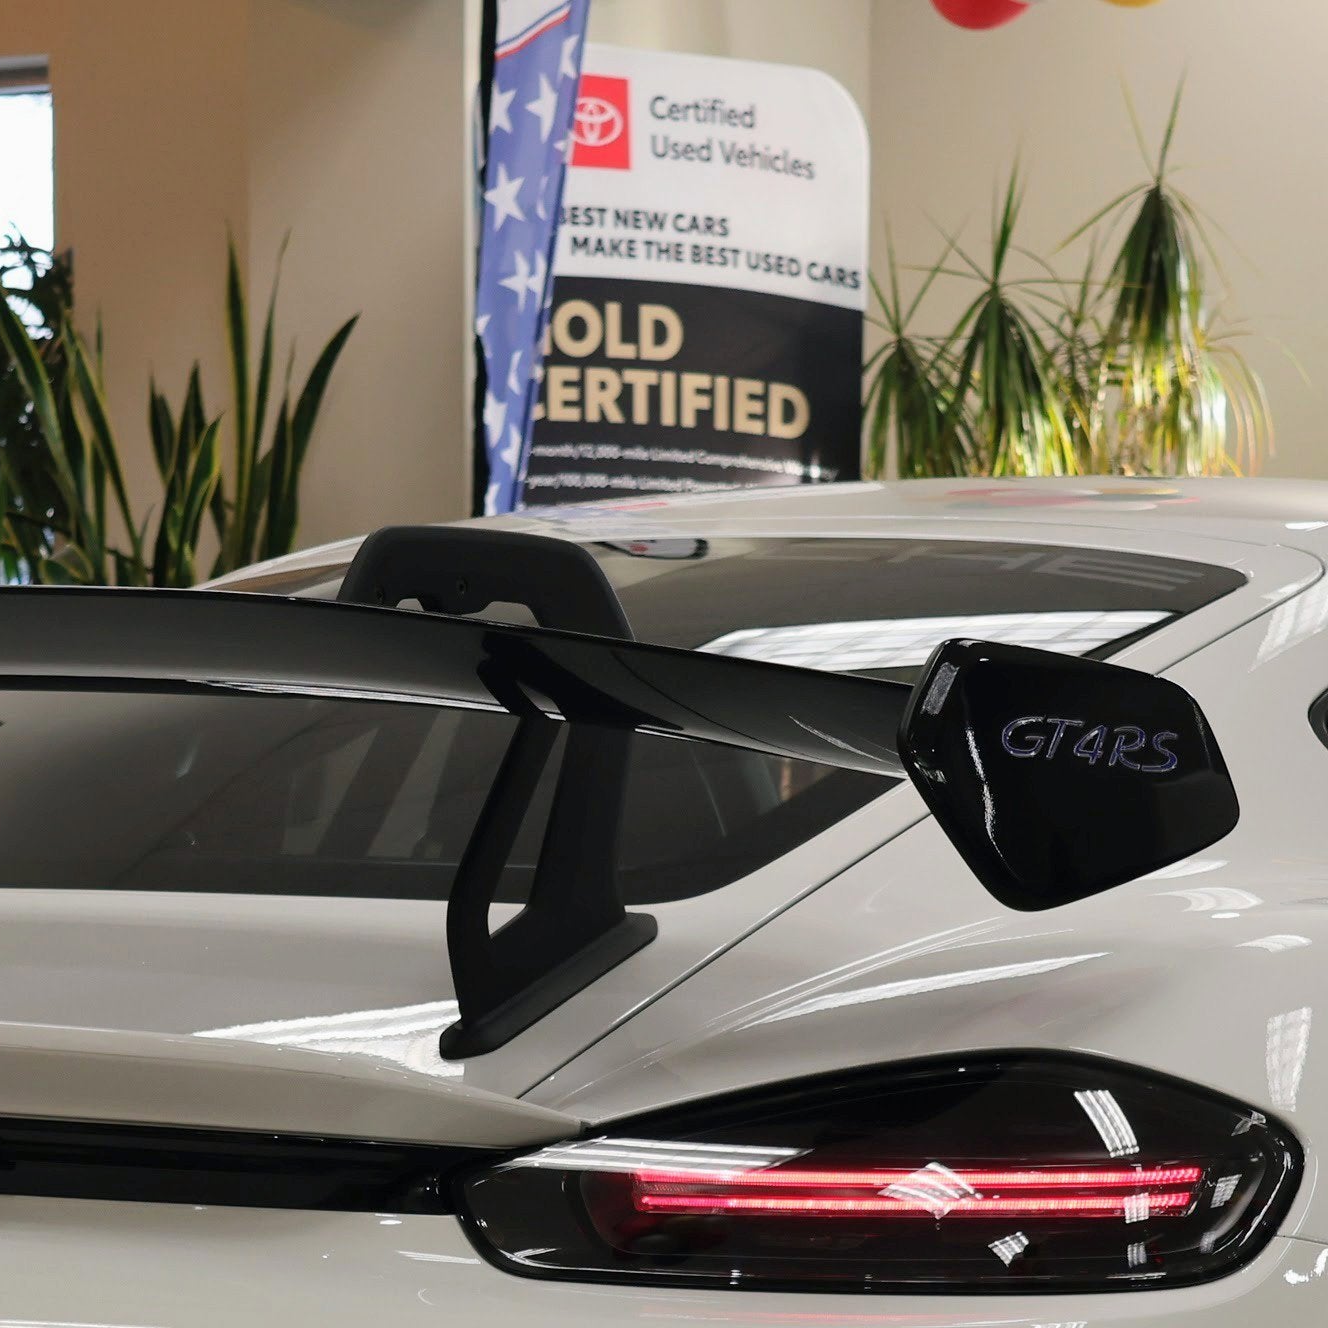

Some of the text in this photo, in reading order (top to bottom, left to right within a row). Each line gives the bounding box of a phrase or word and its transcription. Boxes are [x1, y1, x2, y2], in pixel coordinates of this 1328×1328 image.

[648, 95, 756, 129] Certified
[650, 134, 816, 180] Used Vehicles
[613, 208, 668, 231] NEW
[672, 213, 730, 237] CARS
[571, 235, 862, 290] MAKE THE BEST USED CARS
[540, 299, 684, 362] OLD
